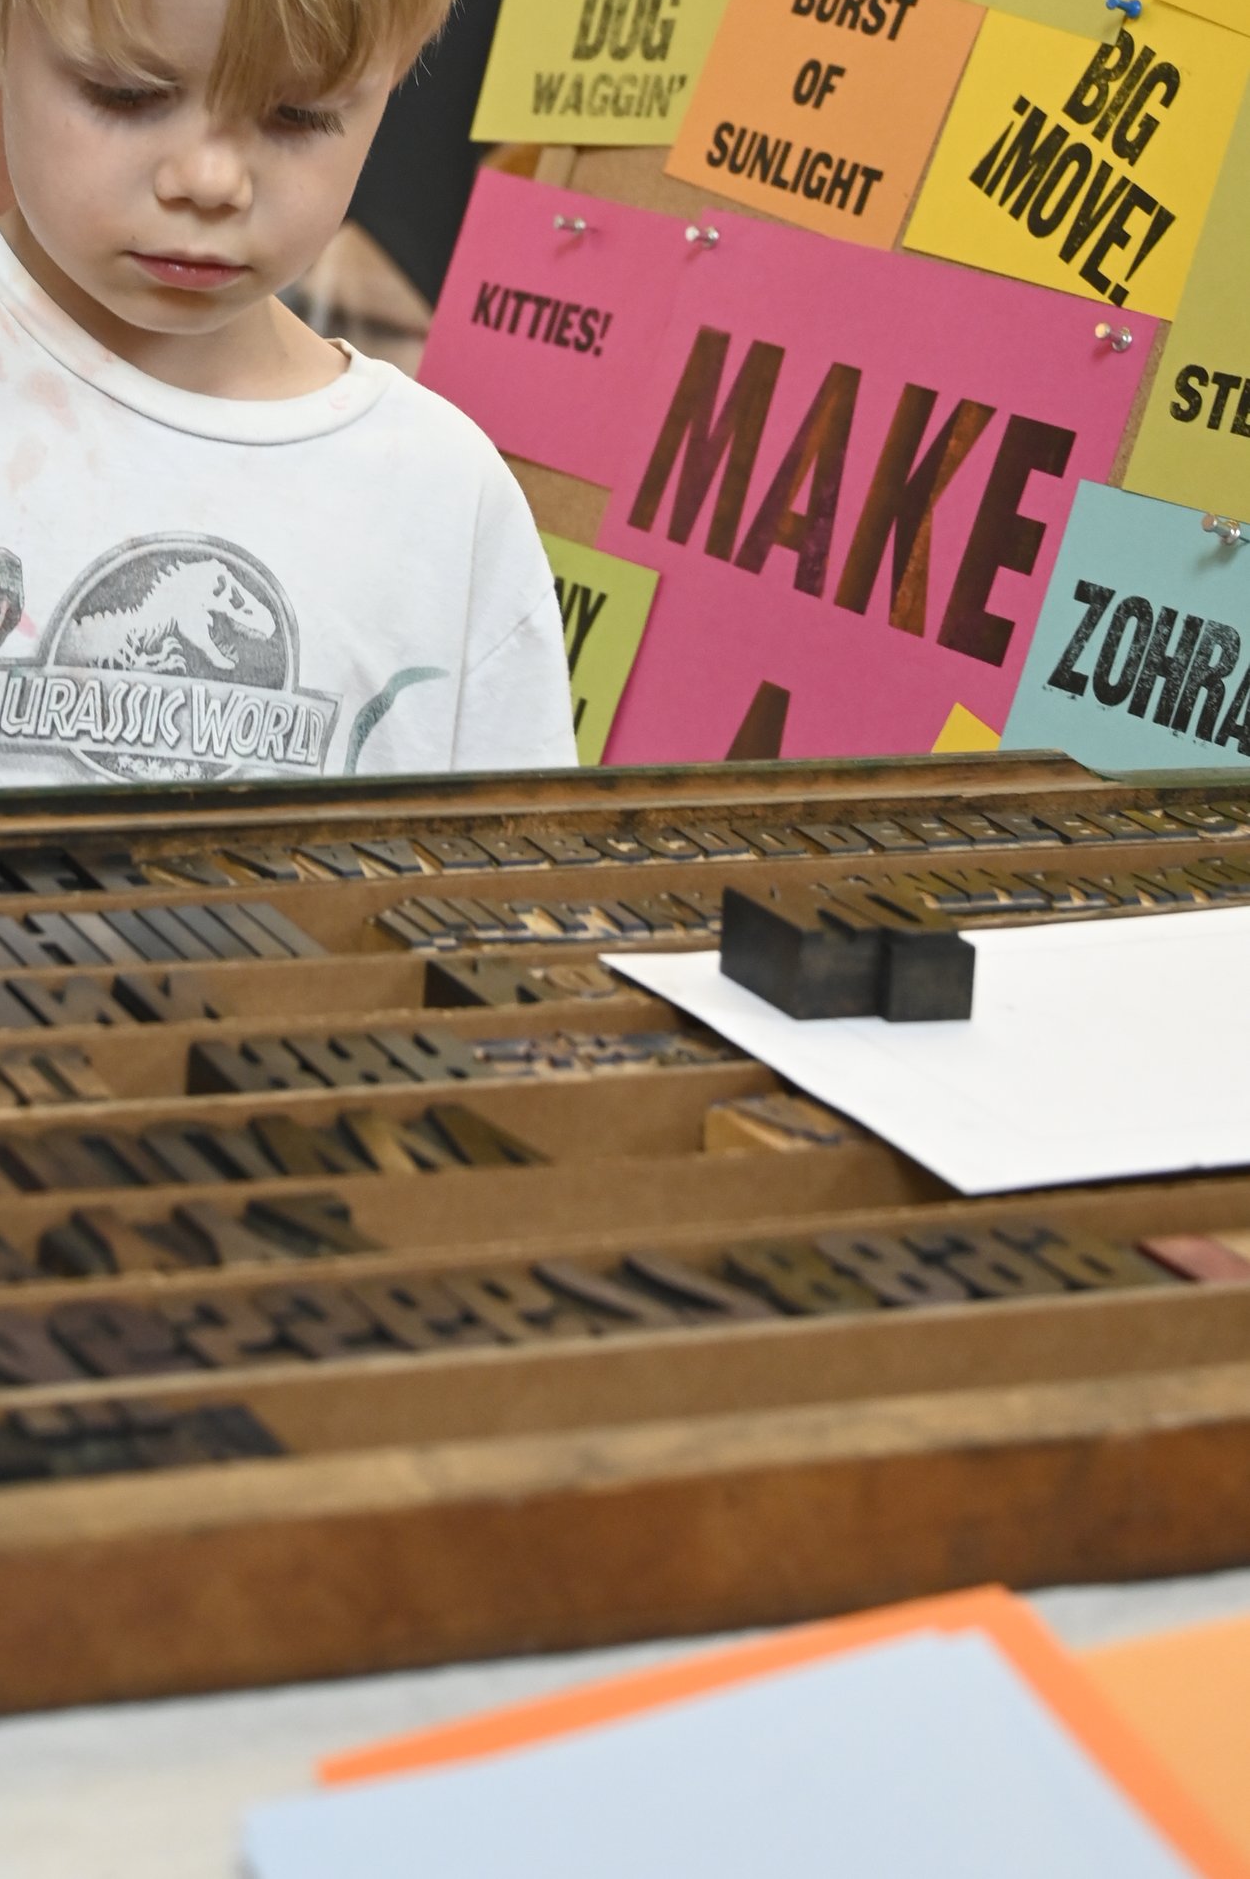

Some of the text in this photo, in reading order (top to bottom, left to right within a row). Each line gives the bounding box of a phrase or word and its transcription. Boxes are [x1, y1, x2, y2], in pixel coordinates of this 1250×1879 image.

[532, 72, 687, 118] WAGGIN'
[792, 59, 845, 110] OF
[1063, 28, 1181, 165] BIG
[706, 122, 883, 216] SUNLIGHT
[471, 283, 612, 357] KITTIES!
[628, 325, 1076, 668] MAKE
[192, 684, 325, 765] WORLD
